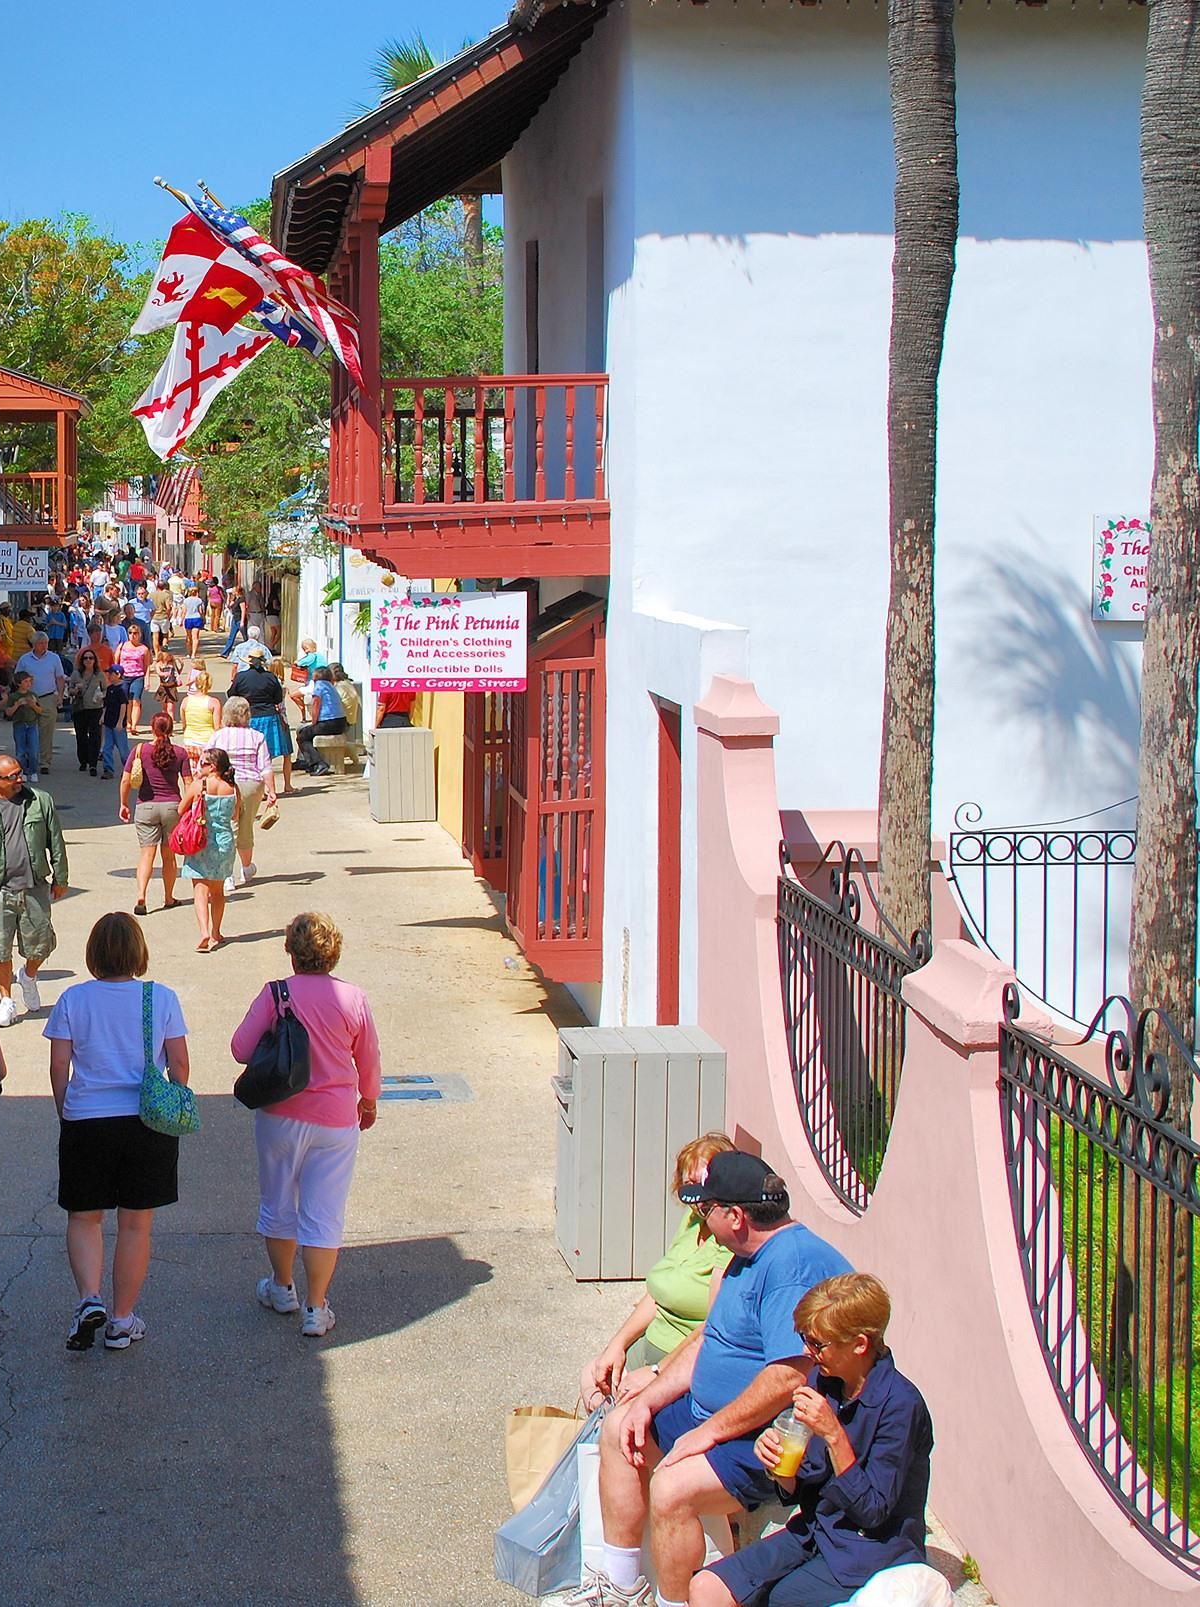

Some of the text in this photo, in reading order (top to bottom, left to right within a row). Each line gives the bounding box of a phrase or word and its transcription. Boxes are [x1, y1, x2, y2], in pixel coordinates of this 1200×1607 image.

[1120, 539, 1150, 556] The
[20, 555, 39, 566] CAT
[27, 567, 45, 578] CAT
[393, 613, 520, 631] The Pink Petunia
[400, 637, 512, 648] Children's Clothing
[406, 649, 506, 658] And Accessories
[407, 664, 503, 673] Collectible Dolls
[379, 679, 520, 690] 97 St. George Street
